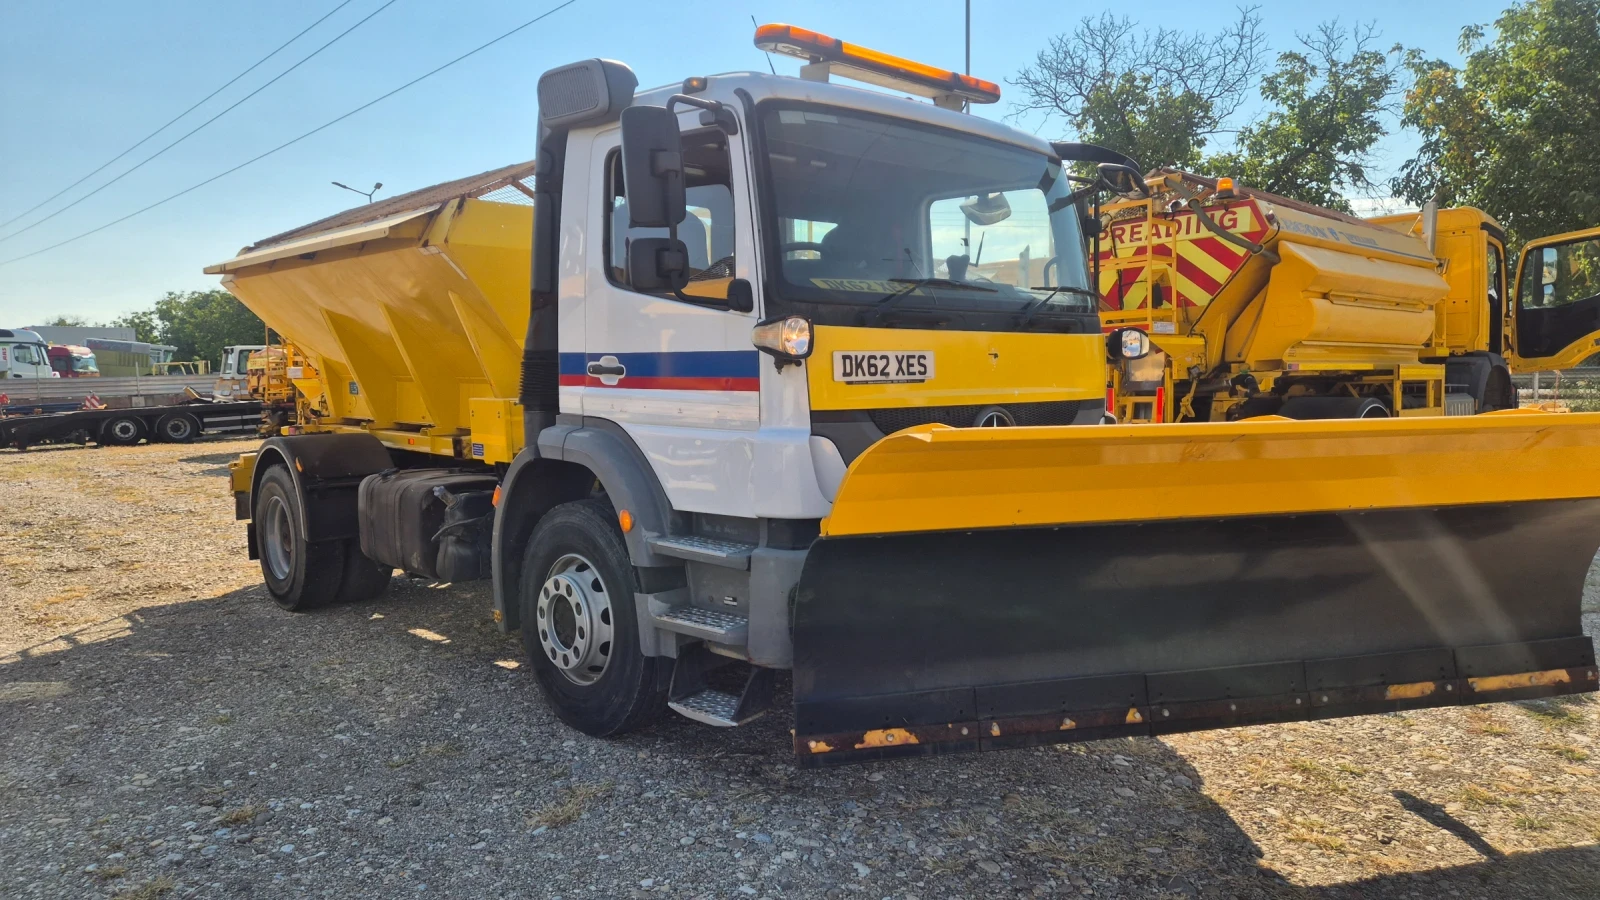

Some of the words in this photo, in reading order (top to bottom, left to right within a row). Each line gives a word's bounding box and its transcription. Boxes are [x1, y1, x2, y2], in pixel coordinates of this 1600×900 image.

[1098, 210, 1238, 244] PREADING
[841, 354, 890, 378] DK62
[894, 354, 928, 377] XES
